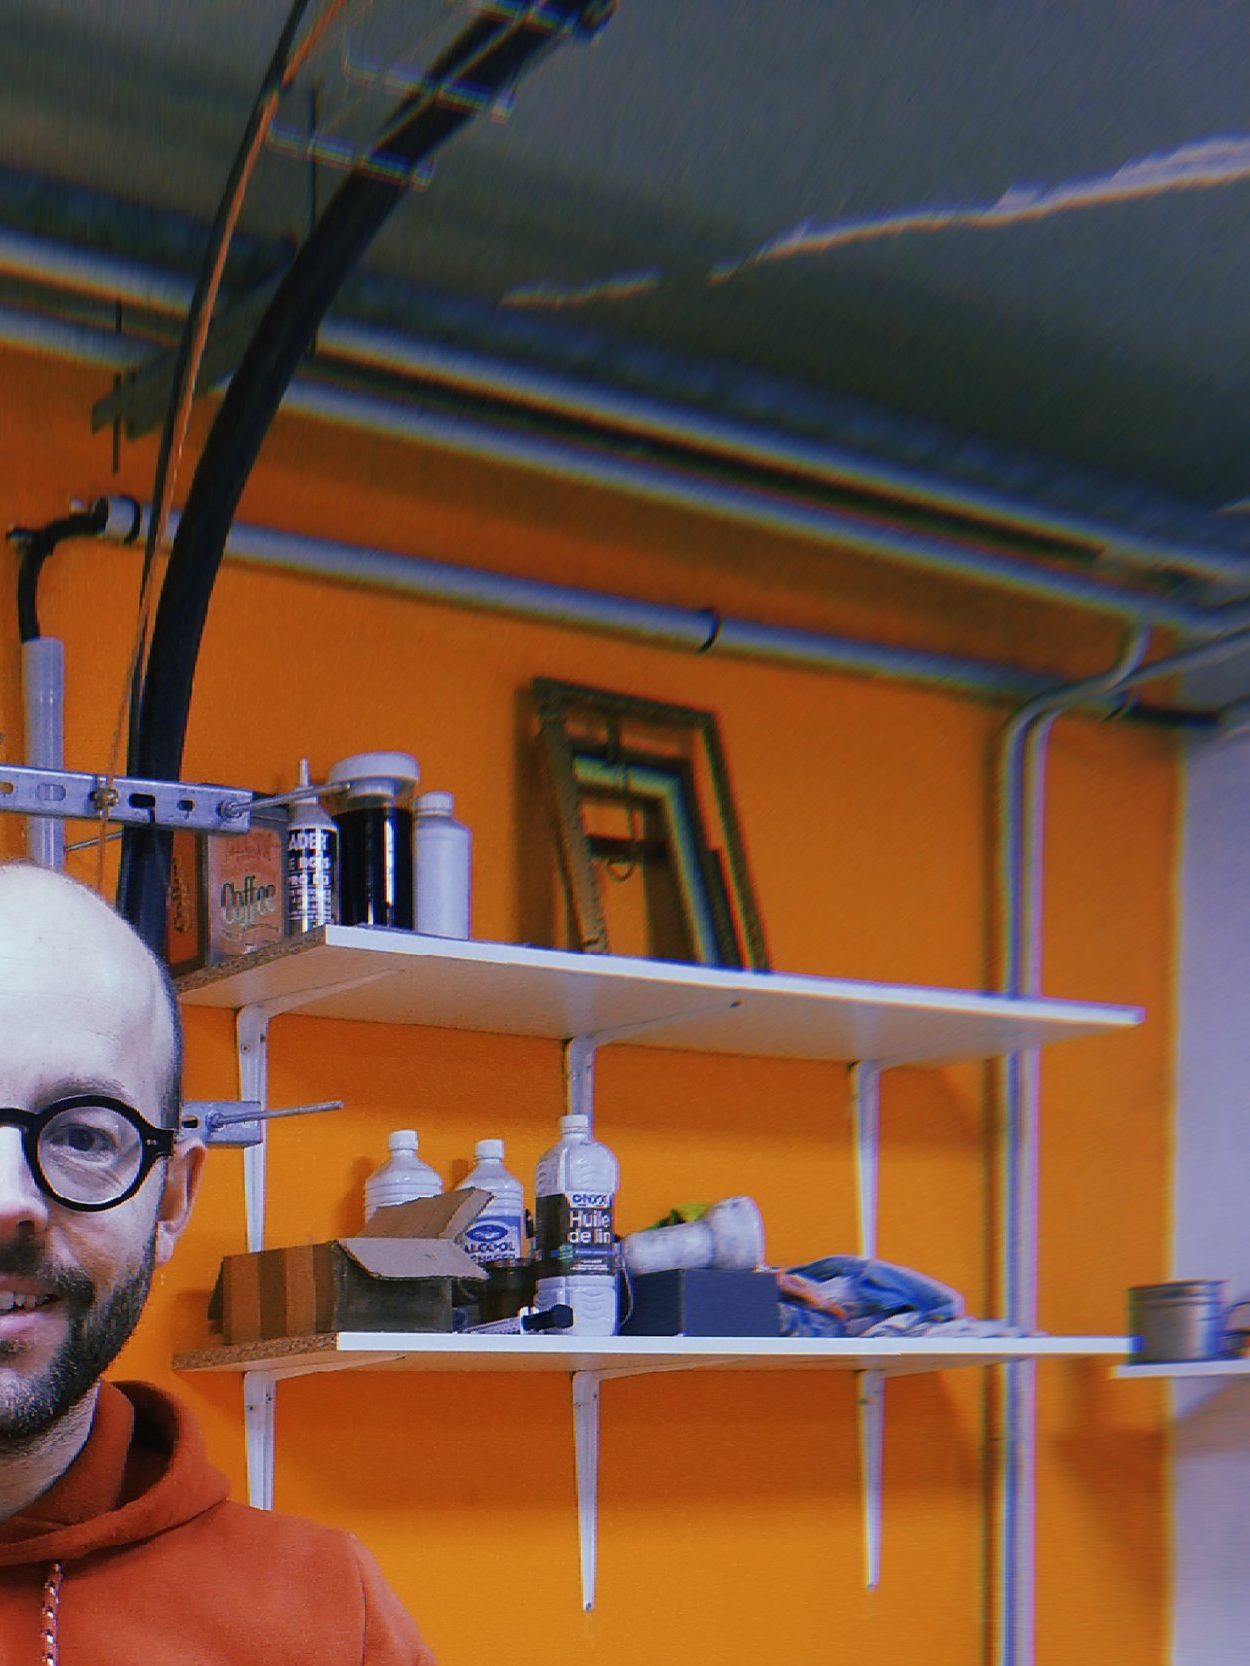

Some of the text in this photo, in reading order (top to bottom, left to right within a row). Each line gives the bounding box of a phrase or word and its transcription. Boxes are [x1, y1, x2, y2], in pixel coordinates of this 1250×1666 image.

[570, 1210, 610, 1228] Huile
[567, 1228, 610, 1244] de lin
